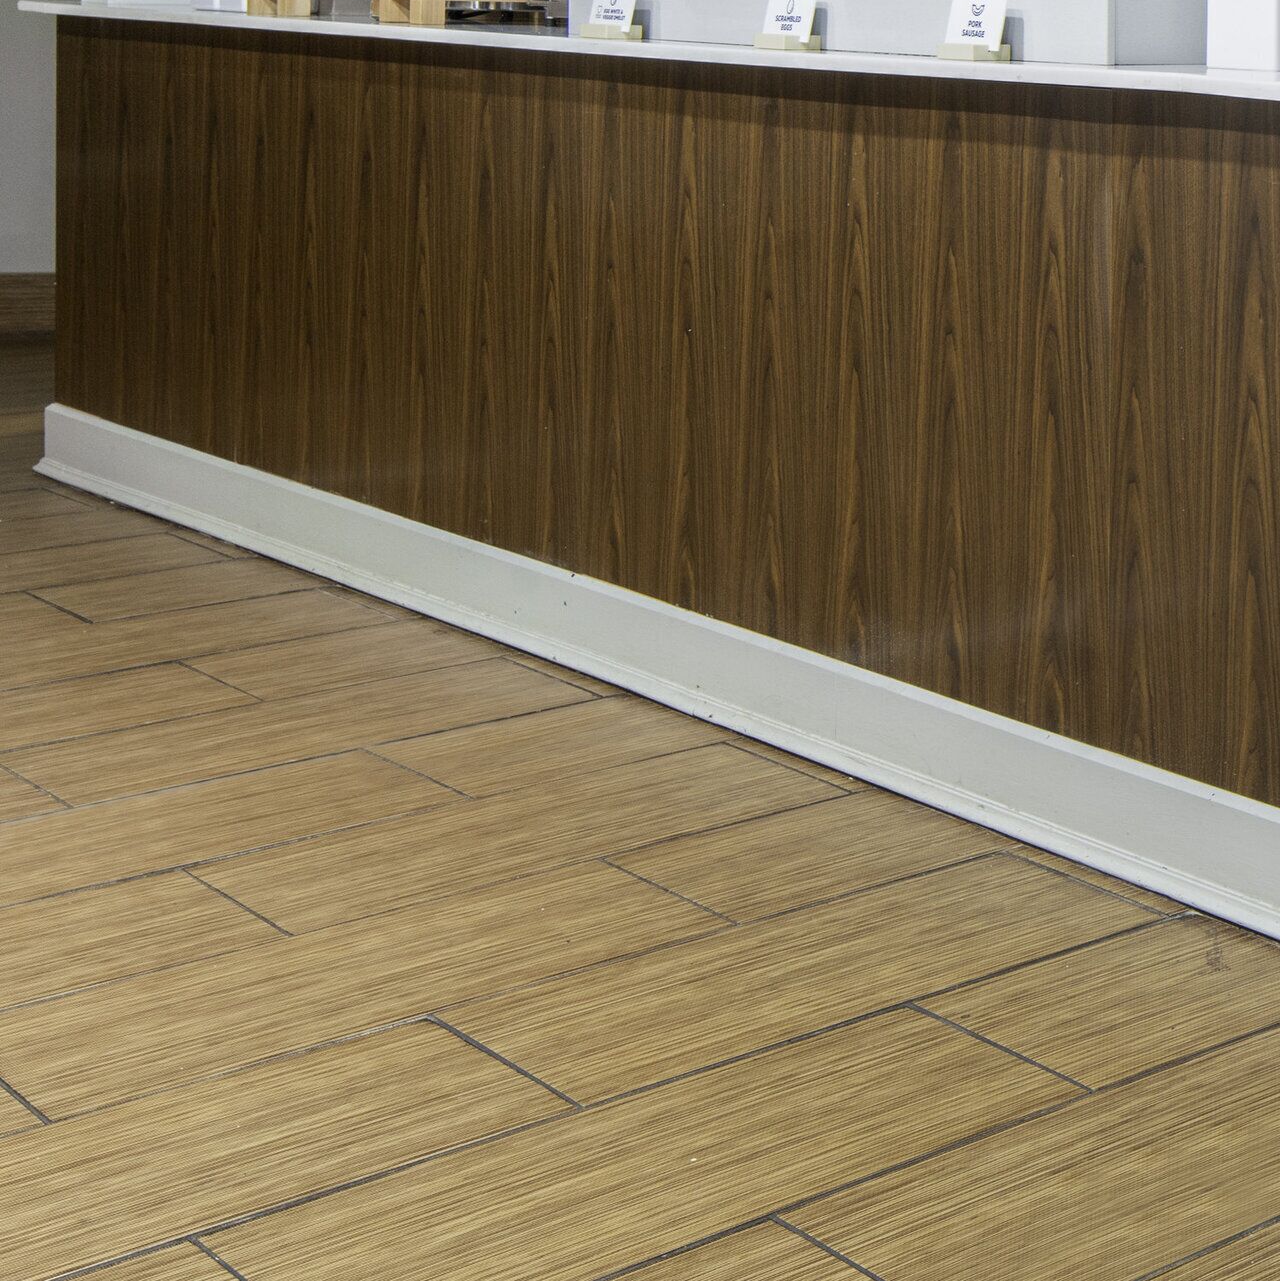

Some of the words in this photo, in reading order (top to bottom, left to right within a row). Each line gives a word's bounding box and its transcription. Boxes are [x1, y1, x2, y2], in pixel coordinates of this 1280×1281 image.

[775, 14, 801, 22] SCRAMBLED
[780, 23, 793, 31] EGGS
[968, 20, 983, 28] PORK
[961, 28, 985, 38] SAUSAGE
